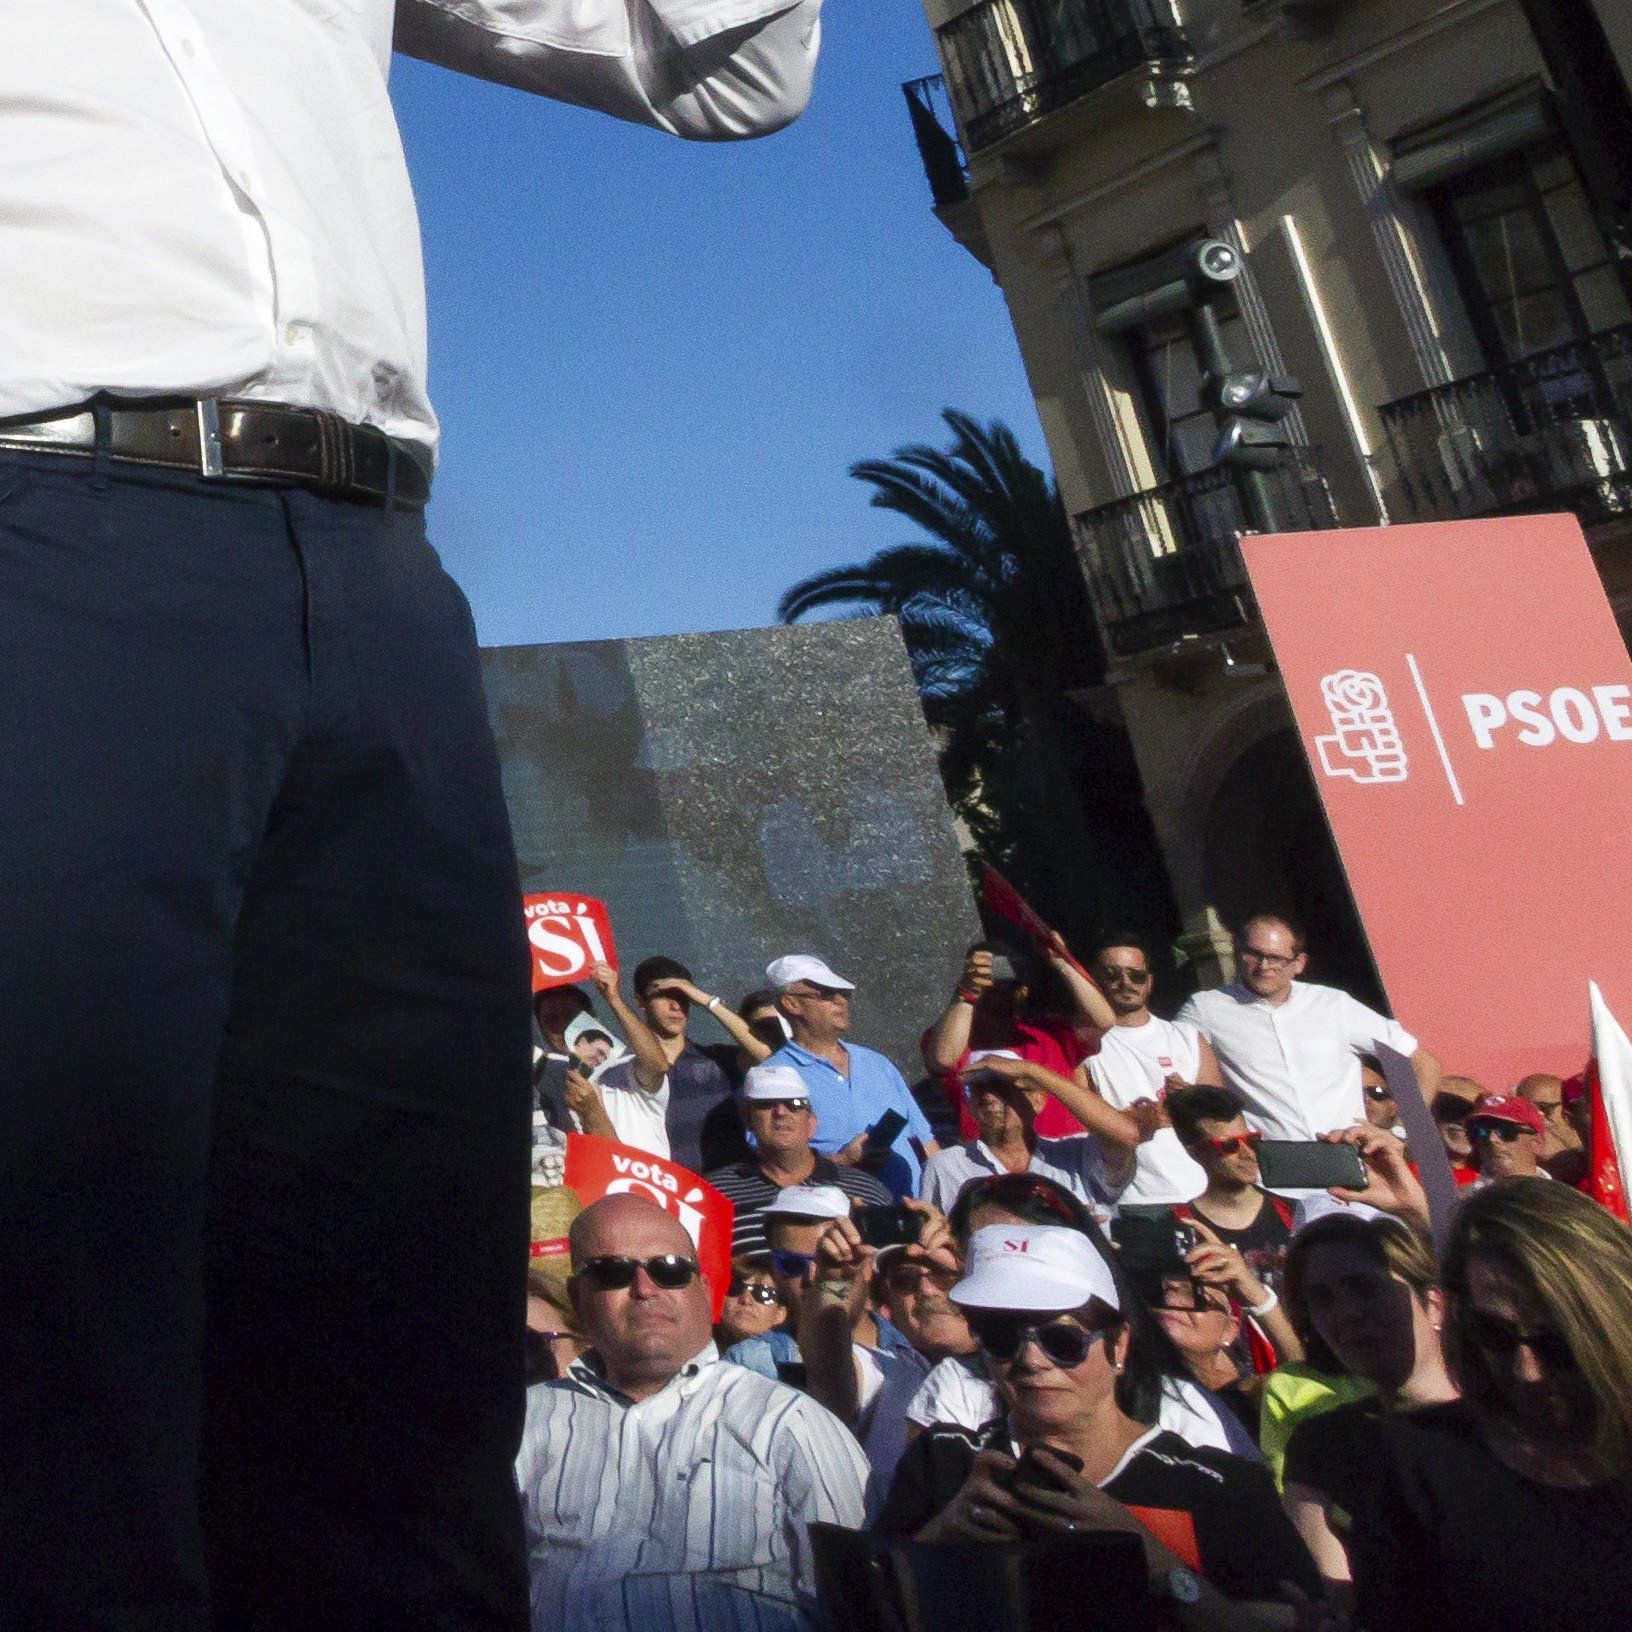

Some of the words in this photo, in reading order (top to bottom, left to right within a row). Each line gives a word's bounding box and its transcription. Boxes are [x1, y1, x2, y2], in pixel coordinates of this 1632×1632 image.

[1461, 684, 1632, 749] PSOE
[524, 900, 571, 918] vota
[528, 903, 608, 977] SÍ
[612, 1154, 679, 1194] vota
